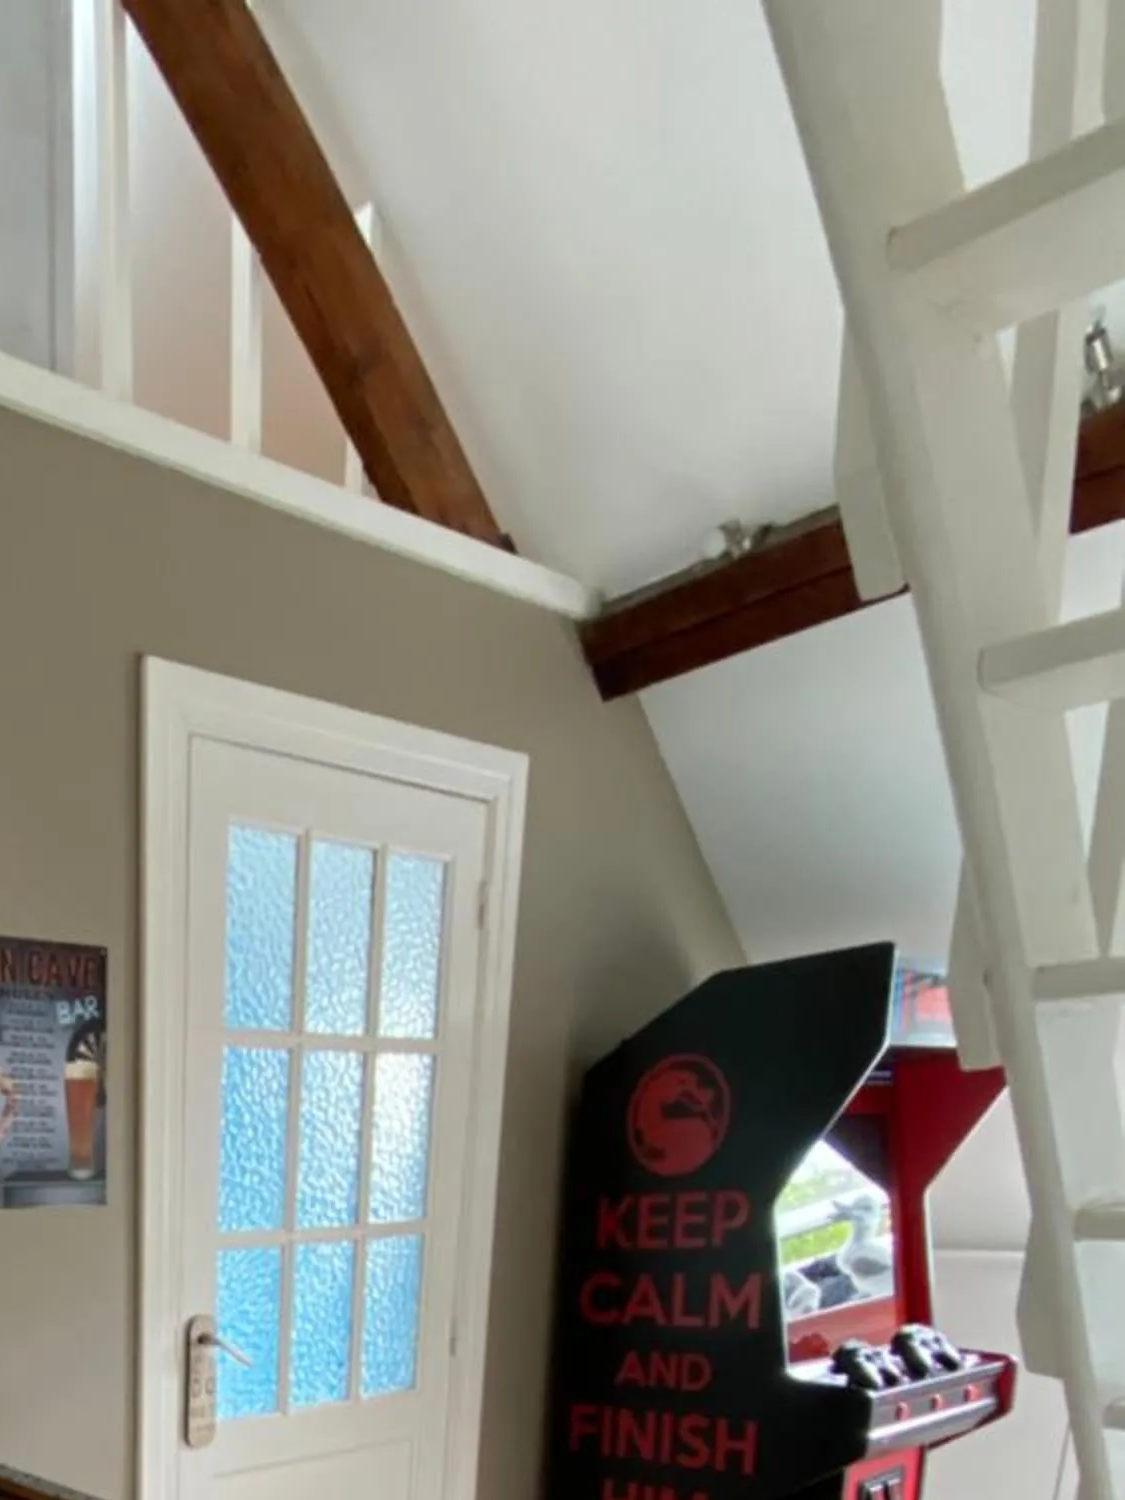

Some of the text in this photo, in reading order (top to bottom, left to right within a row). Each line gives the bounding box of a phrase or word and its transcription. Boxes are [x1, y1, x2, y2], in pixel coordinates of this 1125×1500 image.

[28, 950, 97, 989] CAVE
[57, 995, 101, 1024] BAR
[596, 1190, 751, 1250] KEEP
[579, 1272, 762, 1329] CALM
[614, 1351, 712, 1392] AND
[569, 1405, 758, 1476] FINISH
